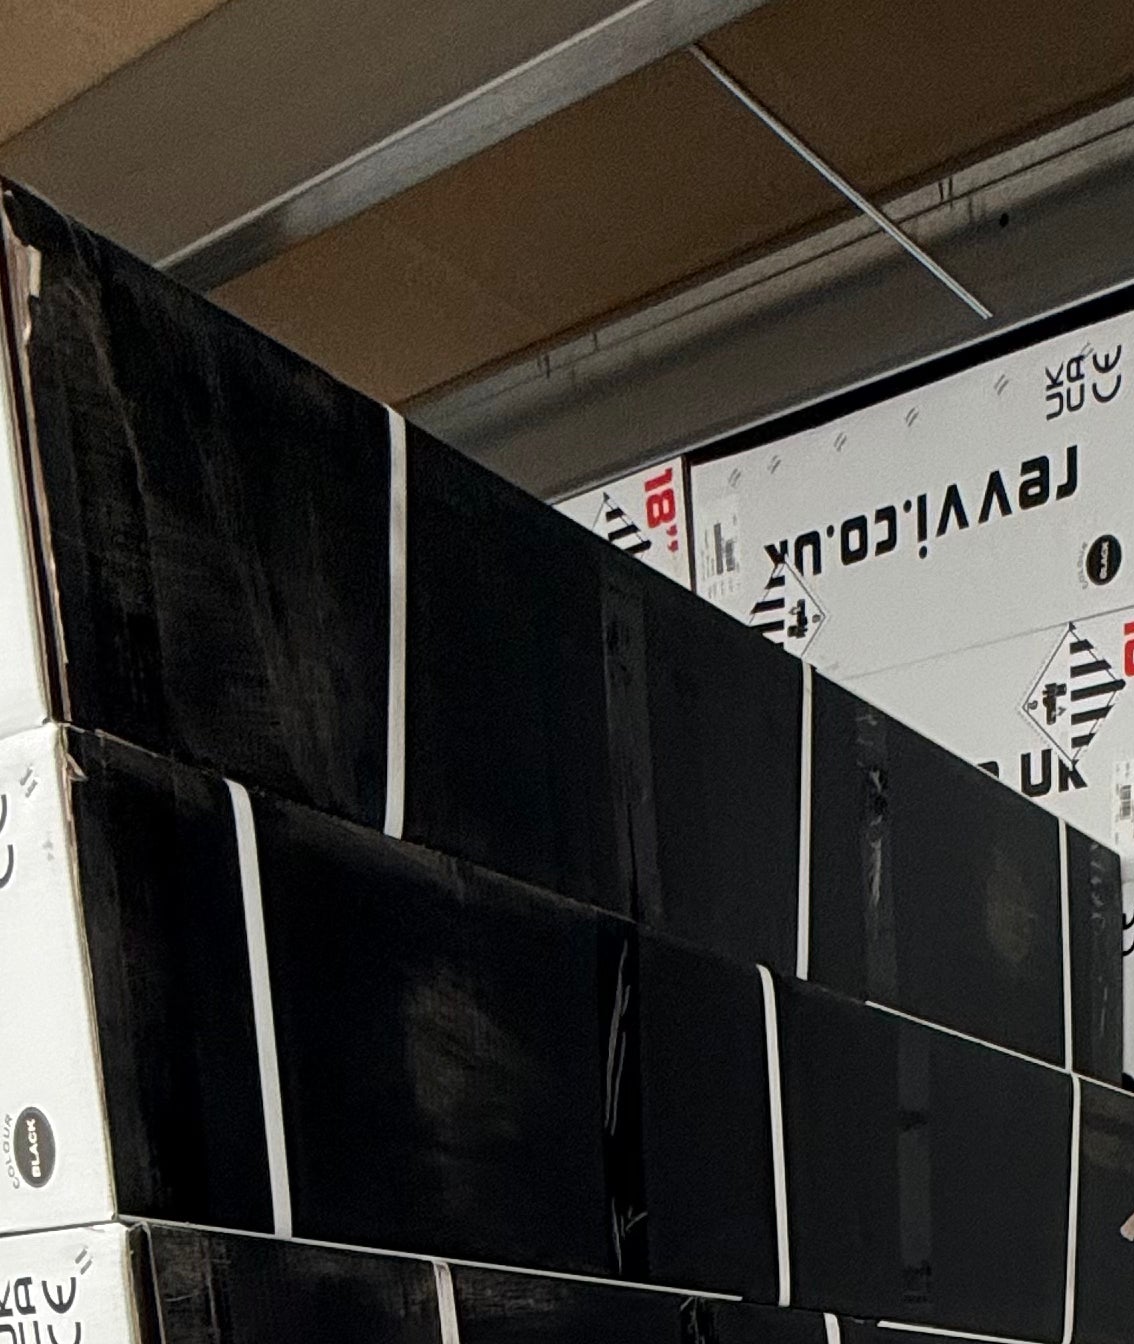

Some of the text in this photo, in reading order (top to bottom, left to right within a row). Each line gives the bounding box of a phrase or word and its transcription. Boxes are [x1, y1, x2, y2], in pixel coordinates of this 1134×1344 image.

[765, 445, 1077, 576] revvi.co.uk
[4, 1113, 20, 1190] COLOUR
[30, 1118, 41, 1178] BLACK
